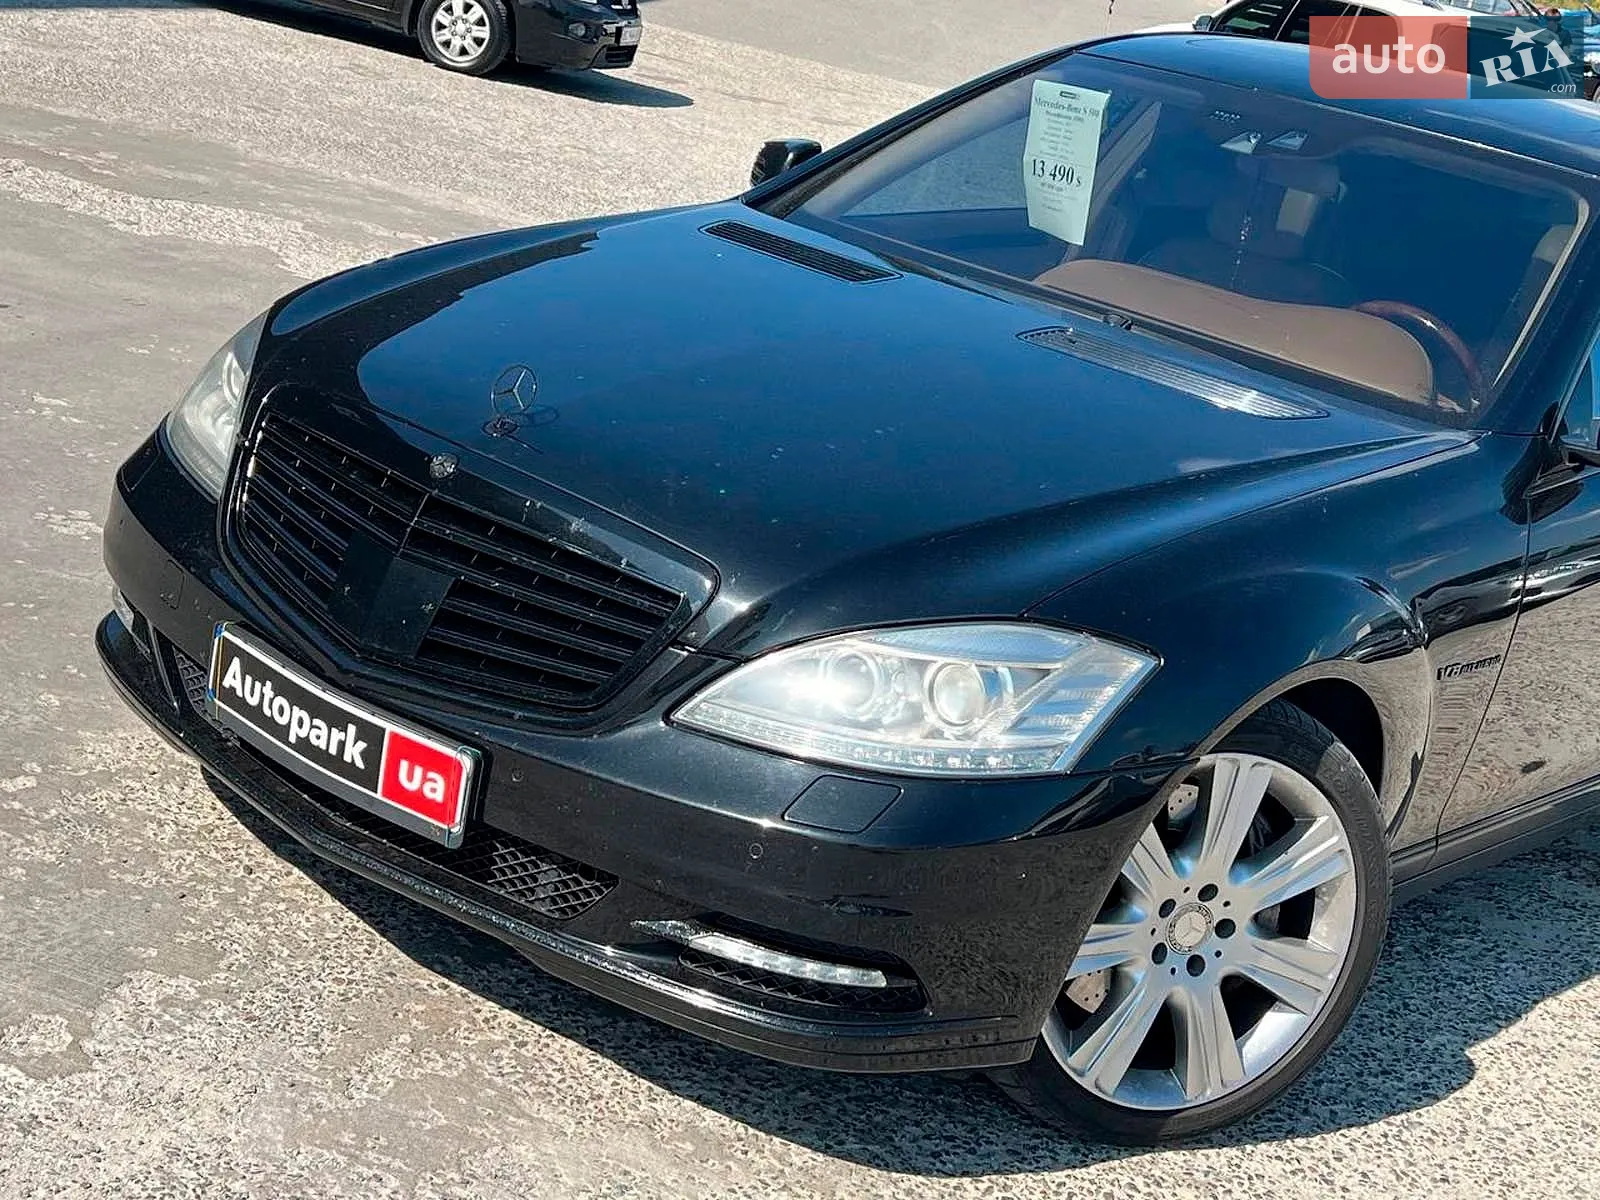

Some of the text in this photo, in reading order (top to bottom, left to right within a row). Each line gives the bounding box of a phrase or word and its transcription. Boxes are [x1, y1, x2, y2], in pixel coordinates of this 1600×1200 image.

[1034, 95, 1082, 115] Mercedes-Benz
[1032, 158, 1046, 179] 13
[1049, 162, 1075, 186] 490
[222, 655, 446, 804] Autopark ua
